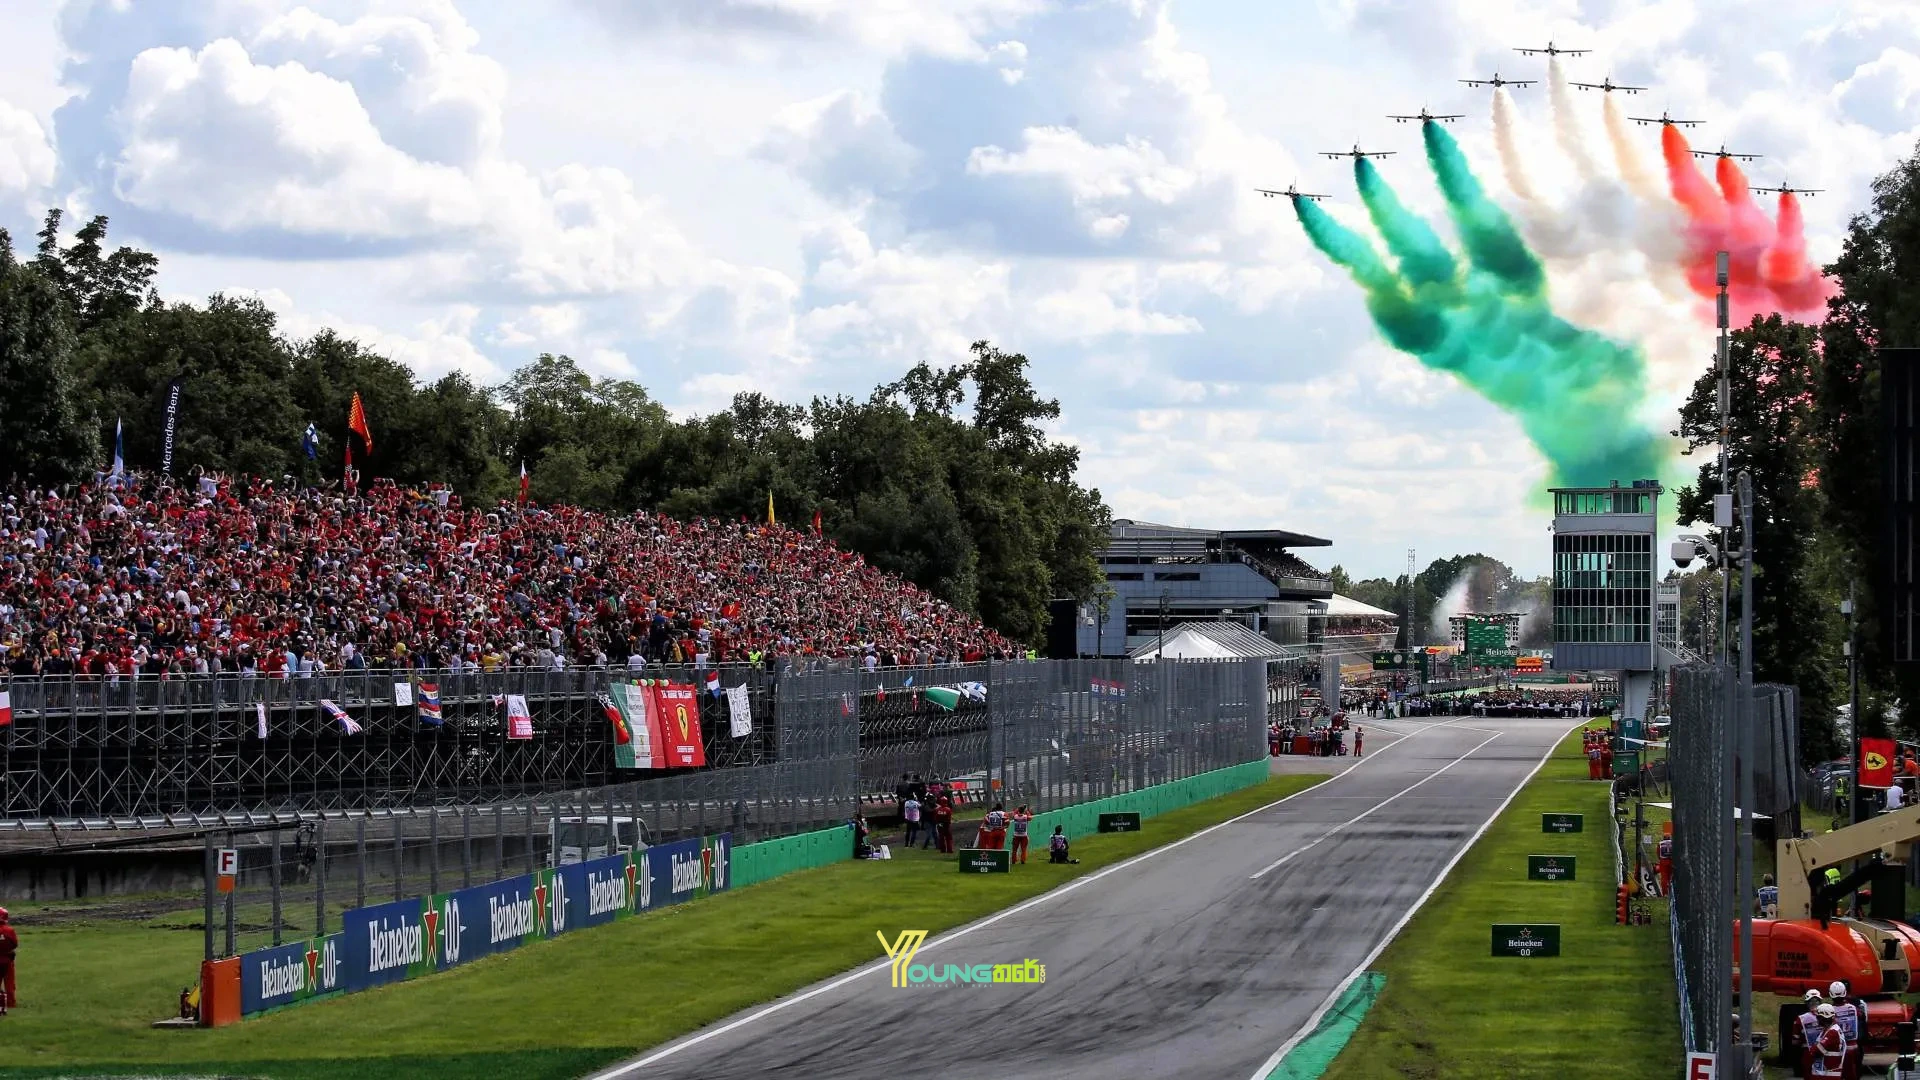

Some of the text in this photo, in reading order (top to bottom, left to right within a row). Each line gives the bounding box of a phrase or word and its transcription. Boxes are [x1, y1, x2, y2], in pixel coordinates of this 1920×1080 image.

[162, 385, 180, 471] Mercedes-Benz
[222, 852, 234, 871] F
[671, 851, 702, 894] Heineken
[588, 868, 626, 916] Heineken
[489, 890, 534, 944] Heineken
[368, 915, 423, 973] Heineken
[1508, 939, 1543, 947] Heineken
[261, 955, 305, 999] Heineken
